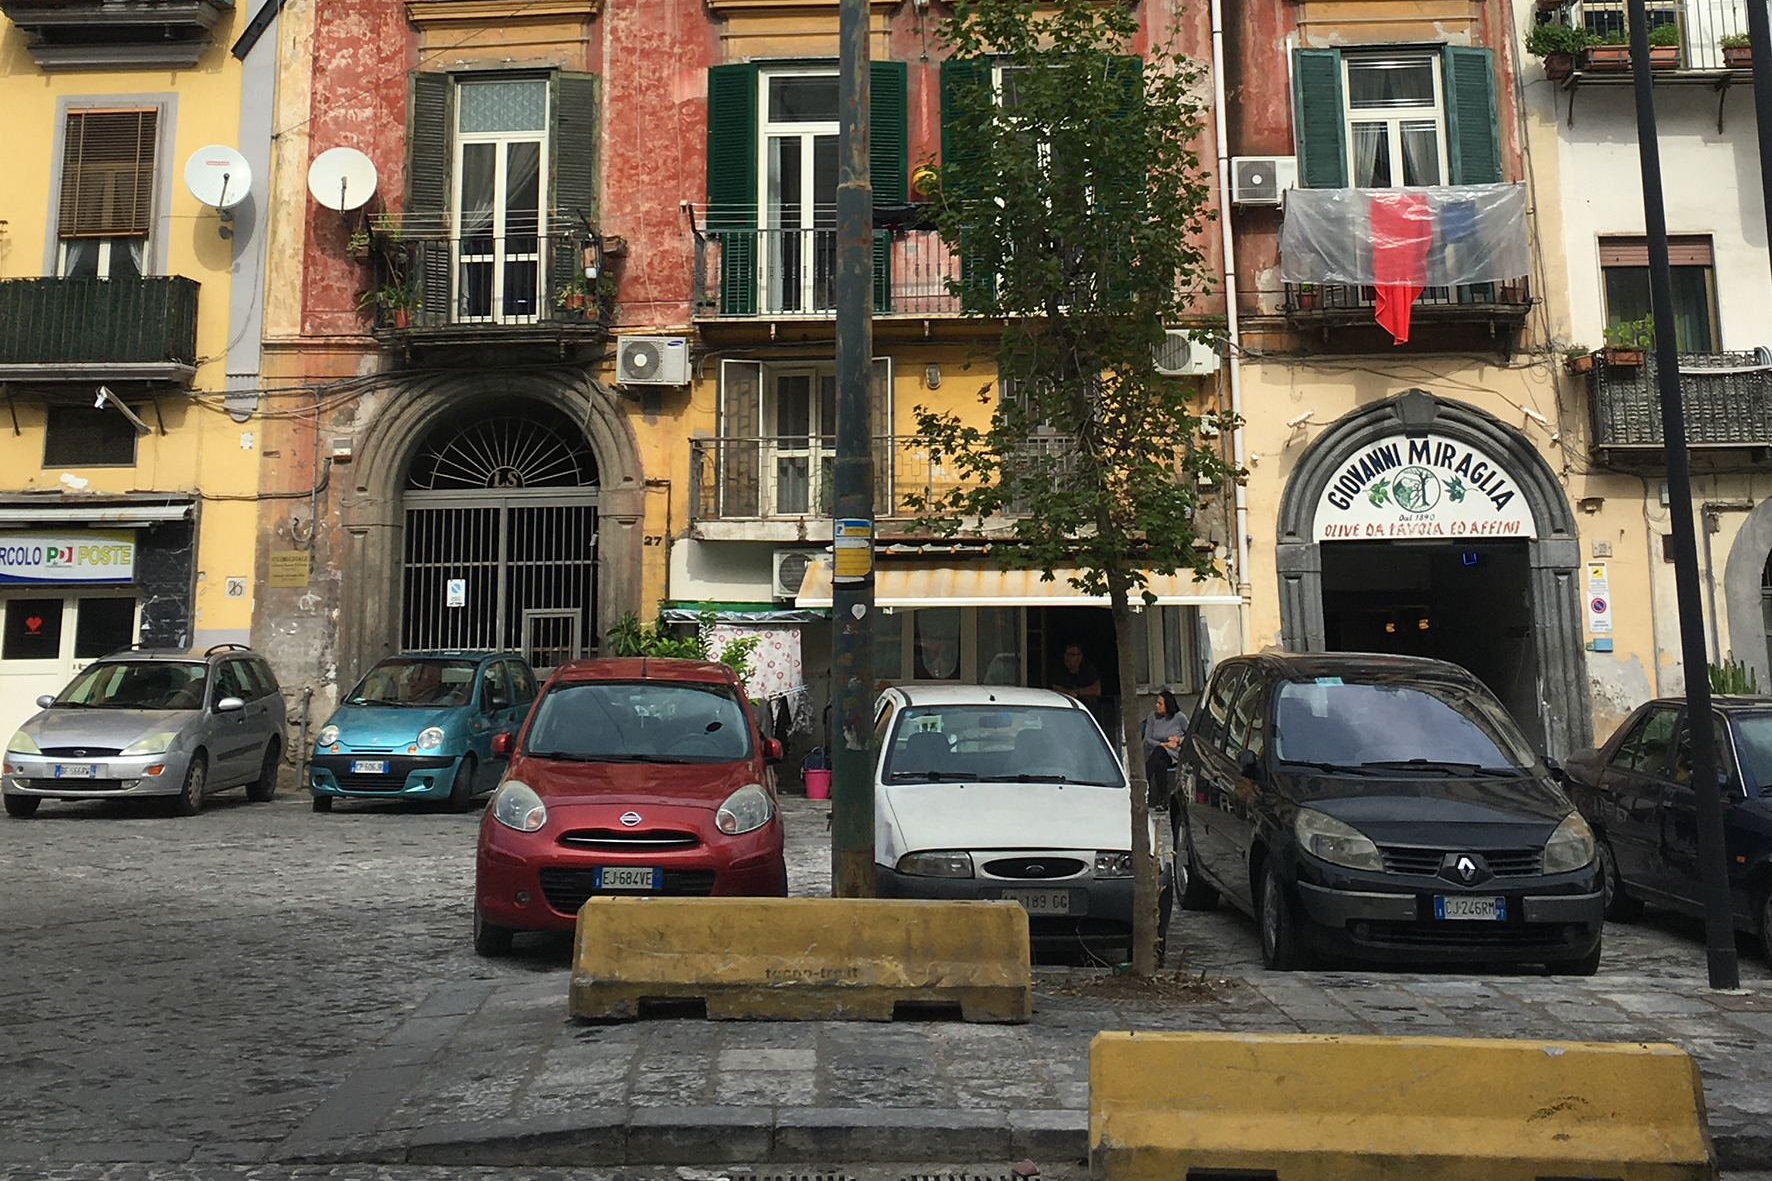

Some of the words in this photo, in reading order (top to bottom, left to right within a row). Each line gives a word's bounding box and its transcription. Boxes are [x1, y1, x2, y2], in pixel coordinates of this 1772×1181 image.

[1327, 442, 1403, 511] GIOVANNI
[1408, 439, 1516, 513] MIRAGLIA
[1415, 513, 1436, 522] 1890
[1324, 523, 1360, 538] OLIVE
[1365, 522, 1385, 537] DA
[1450, 521, 1467, 535] ED
[1469, 520, 1521, 535] AFFINI
[643, 535, 663, 547] 27
[77, 545, 132, 566] POSTE
[1025, 895, 1047, 909] 189
